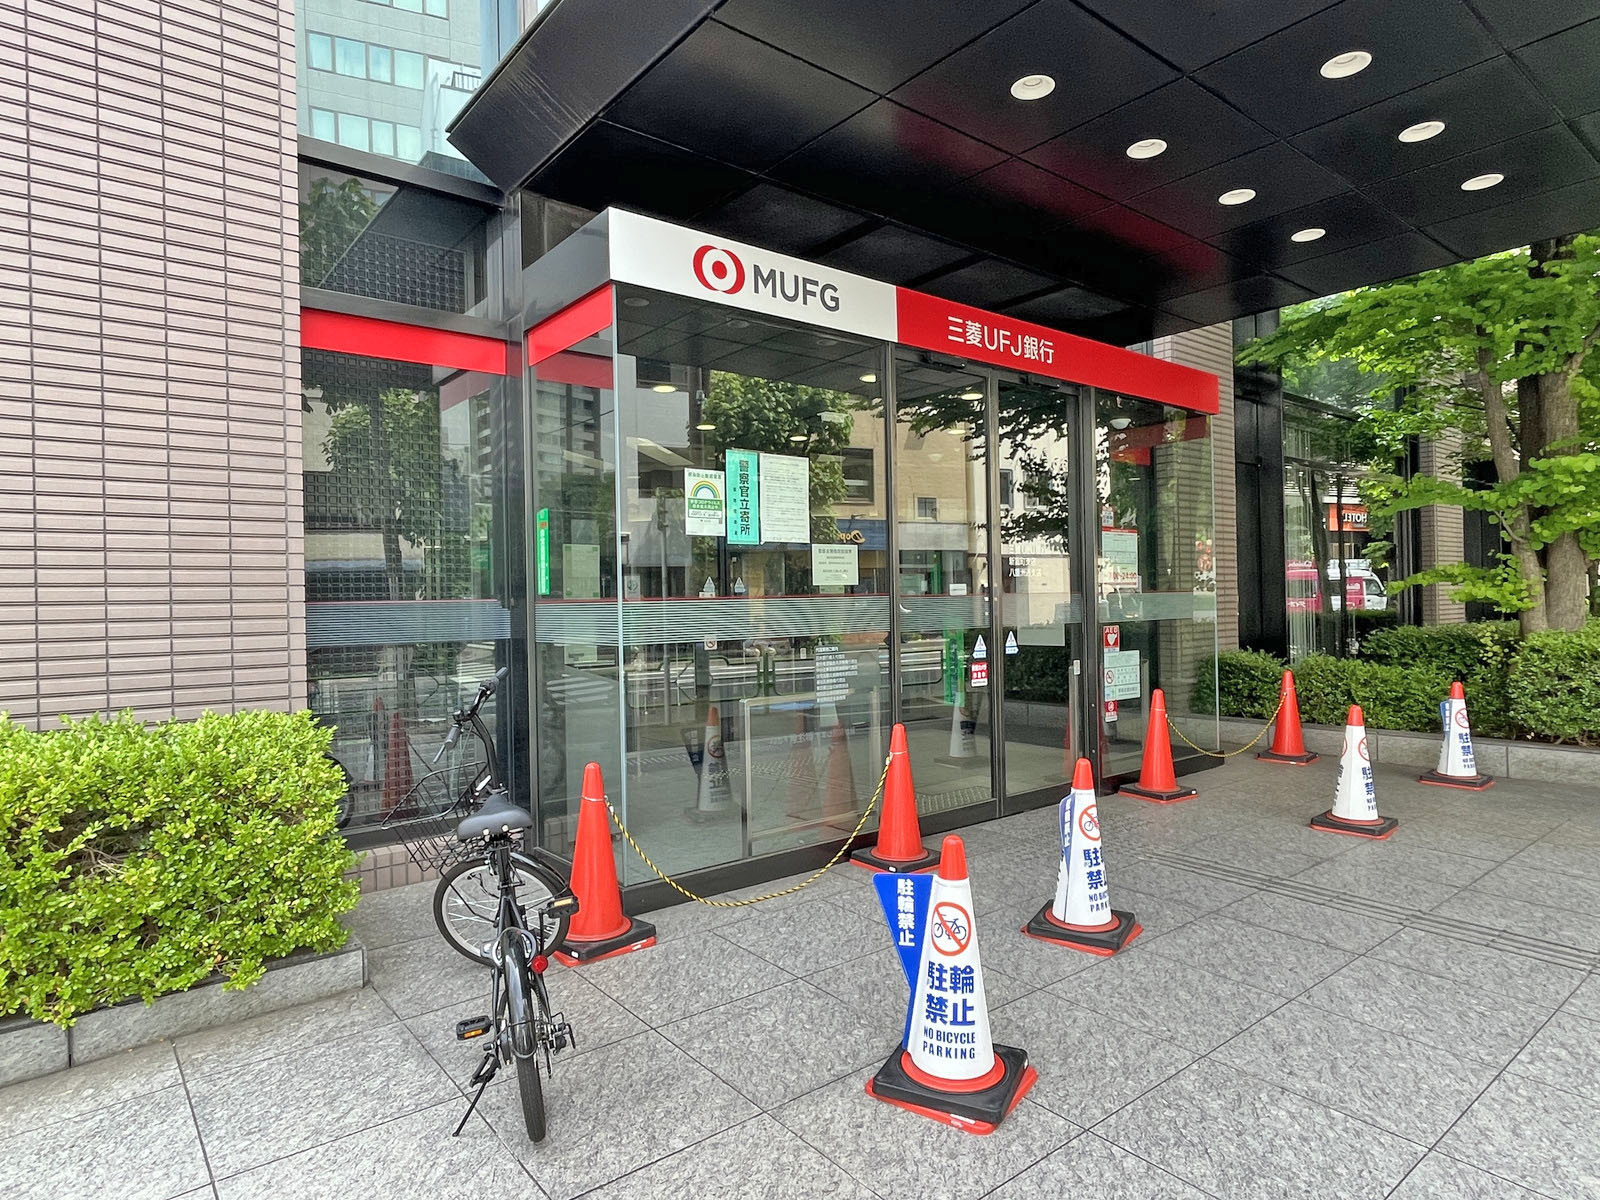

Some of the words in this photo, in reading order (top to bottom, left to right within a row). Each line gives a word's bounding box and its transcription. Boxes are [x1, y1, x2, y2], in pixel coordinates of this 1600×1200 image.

[752, 264, 841, 312] MUFG
[947, 314, 1055, 365] 三菱UFJ銀行
[739, 459, 751, 536] 警察官立寄所
[896, 878, 915, 947] 駐輪禁止
[927, 960, 975, 995] 駐輪
[925, 994, 976, 1026] 禁止
[923, 1025, 934, 1040] NO
[936, 1030, 975, 1044] BICYCLE
[923, 1040, 976, 1060] PARKING
